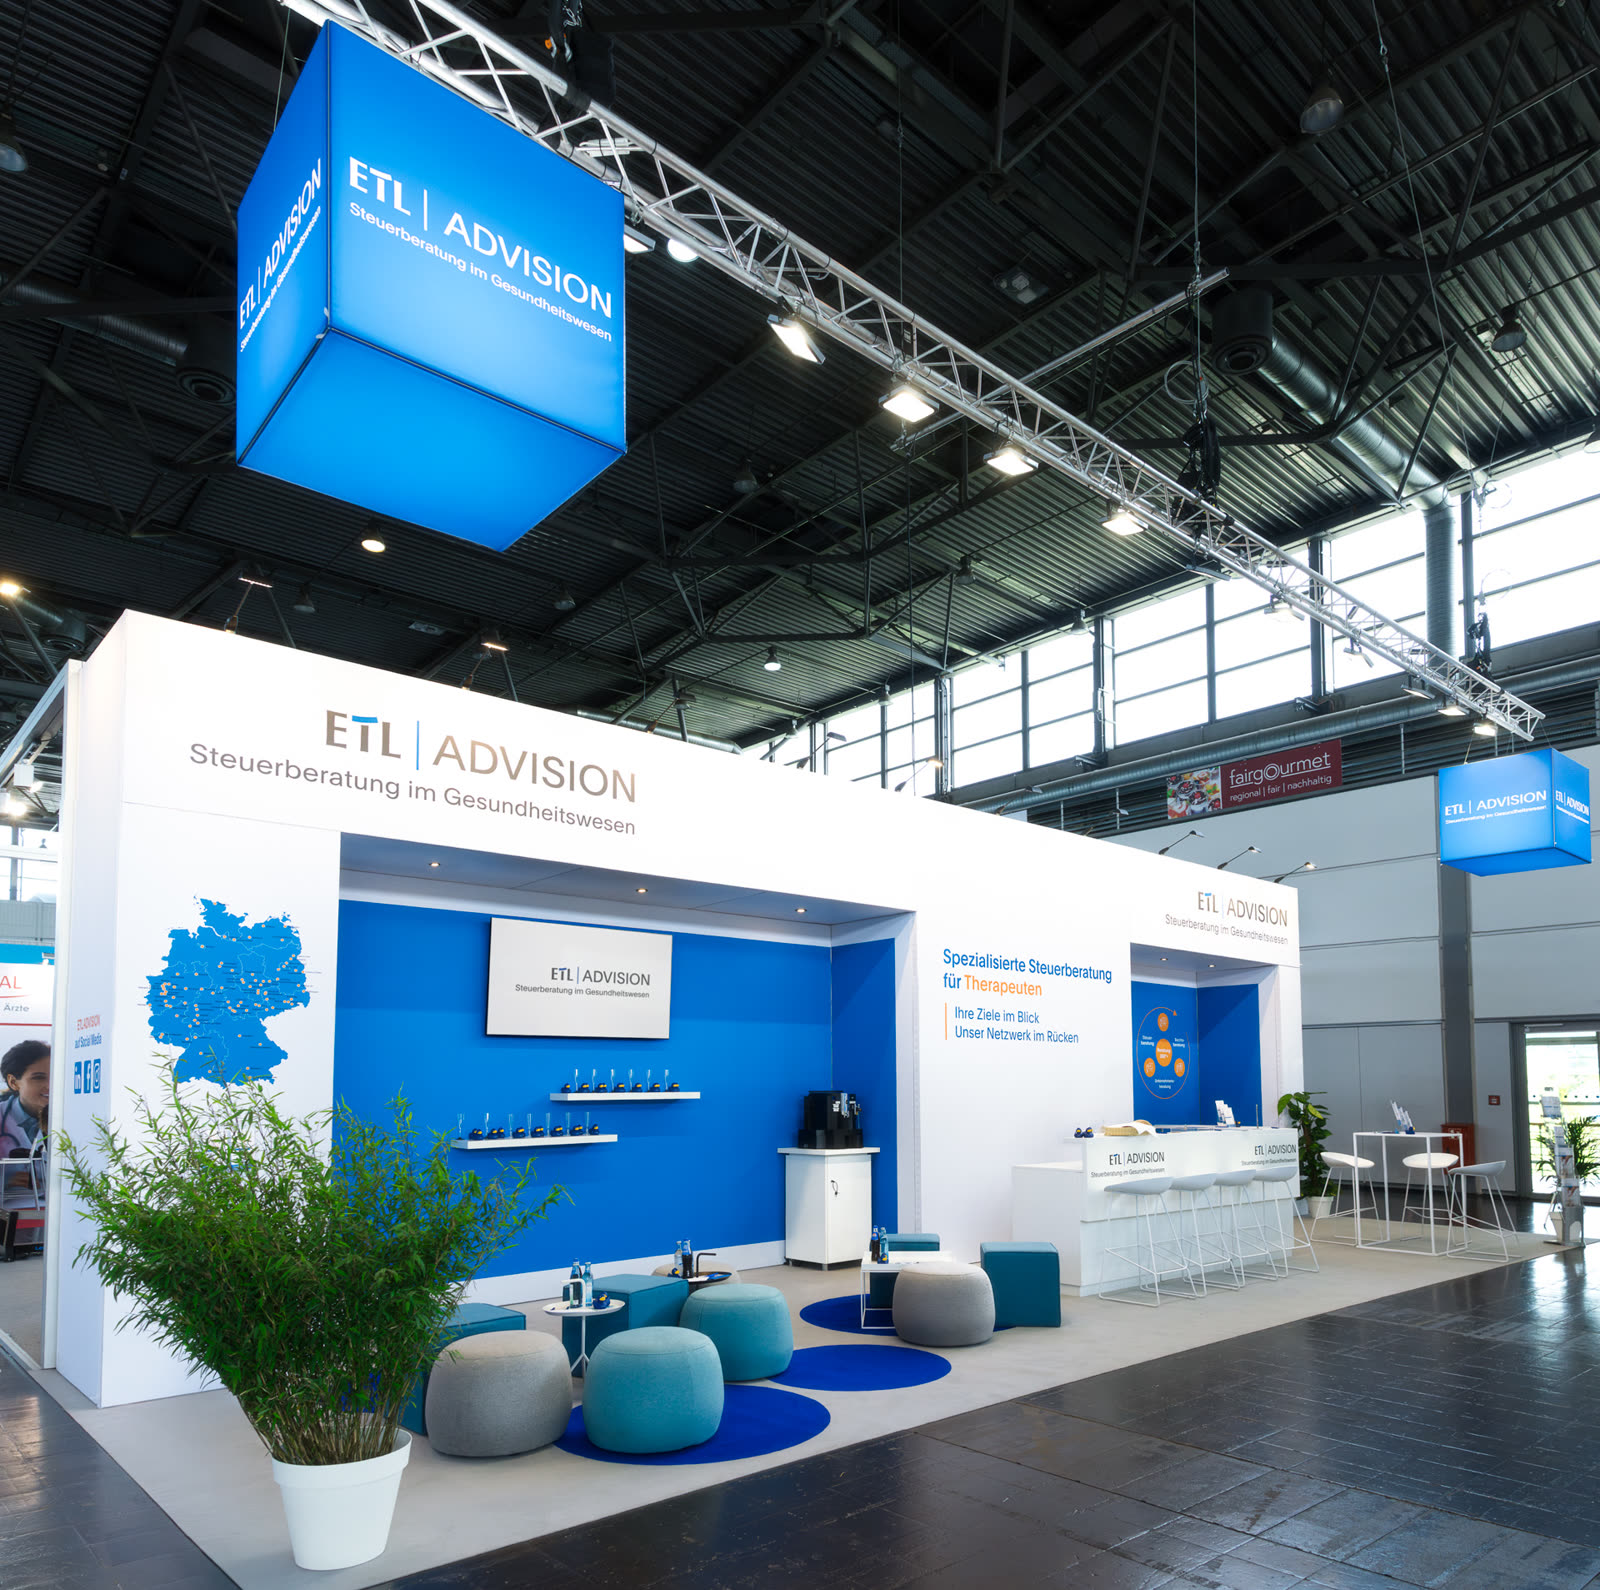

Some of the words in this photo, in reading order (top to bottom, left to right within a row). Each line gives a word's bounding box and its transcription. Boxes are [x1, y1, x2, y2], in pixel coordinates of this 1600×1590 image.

[240, 284, 256, 330] ETL
[263, 158, 321, 288] ADVISION
[349, 156, 411, 216] ETL
[443, 212, 612, 319] ADVISION
[349, 201, 467, 272] Steuerberatung
[470, 262, 488, 281] im
[491, 273, 612, 342] Gesundheitswesen
[325, 709, 402, 760] ETL
[432, 735, 636, 804] ADVISION
[189, 743, 400, 800] Steuerberatung
[408, 780, 436, 802] im
[444, 787, 636, 836] Gesundheitswesen
[1230, 788, 1261, 802] regional
[1267, 785, 1280, 795] fair
[1287, 775, 1332, 790] nachhaltig
[1445, 803, 1465, 816] ETL
[1476, 790, 1547, 812] ADVISION
[1555, 790, 1564, 804] ETL
[1566, 796, 1590, 817] ADVISION
[1198, 891, 1219, 914] ETL
[1226, 898, 1288, 927] ADVISION
[1165, 913, 1219, 936] Steuerberatung
[1220, 925, 1229, 935] im
[1230, 926, 1288, 945] Gesundheitswesen
[551, 967, 573, 982] ETL
[582, 969, 651, 986] ADVISION
[943, 948, 1026, 973] Spezialisierte
[1028, 958, 1112, 984] Steuerberatung
[515, 984, 573, 996] Steuerberatung
[574, 987, 584, 995] im
[585, 988, 650, 999] Gesundheitswesen
[943, 972, 962, 989] für
[964, 974, 1043, 997] Therapeuten
[3, 1002, 30, 1013] Ärzte
[955, 1006, 975, 1020] Ihre
[976, 1007, 1001, 1022] Ziele
[1003, 1010, 1015, 1022] im
[1017, 1011, 1040, 1024] Blick
[955, 1025, 985, 1039] Unser
[986, 1027, 1032, 1041] Netzwerk
[1033, 1030, 1045, 1042] im
[1047, 1030, 1079, 1043] Rücken
[1109, 1153, 1122, 1166] ETL
[1126, 1151, 1165, 1165] ADVISION
[1254, 1145, 1264, 1156] ETL
[1267, 1144, 1297, 1155] ADVISION
[1090, 1170, 1123, 1179] Steuerberatung
[1128, 1167, 1165, 1176] Gesundheitswesen
